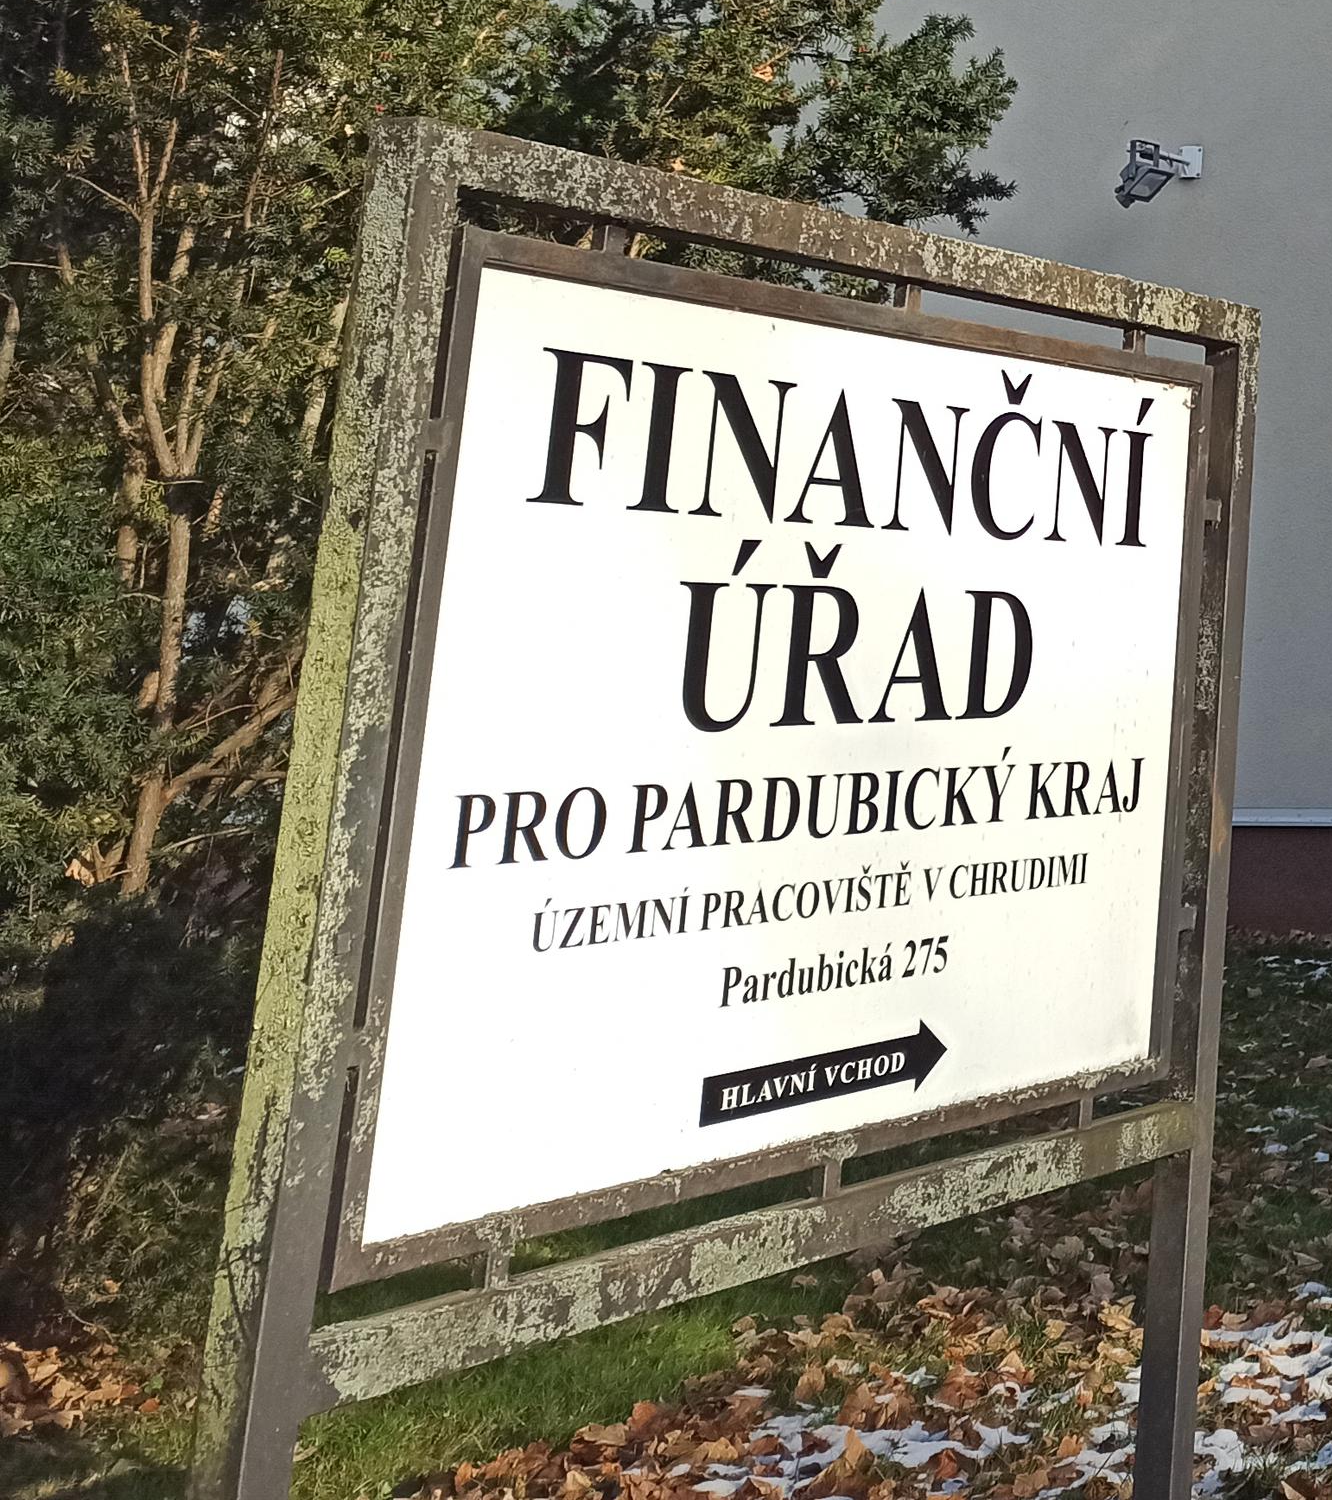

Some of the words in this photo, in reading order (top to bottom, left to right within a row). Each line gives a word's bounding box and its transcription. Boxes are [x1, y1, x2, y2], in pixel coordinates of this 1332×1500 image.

[526, 345, 1153, 547] FINANČNÍ
[679, 540, 1033, 733] ÚŘAD
[448, 787, 606, 869] PRO
[627, 746, 1016, 854] PARDUBICKÝ
[1026, 757, 1146, 820] KRAJ
[531, 893, 691, 953] ÚZEMNÍ
[700, 861, 913, 931] PRACOVIŠTĚ
[922, 866, 943, 901] V
[948, 852, 1088, 899] CHRUDIMI
[718, 945, 894, 1008] Pardubická
[901, 935, 949, 979] 275
[719, 1063, 817, 1111] HLAVNÍ
[824, 1051, 906, 1087] VCHOD
